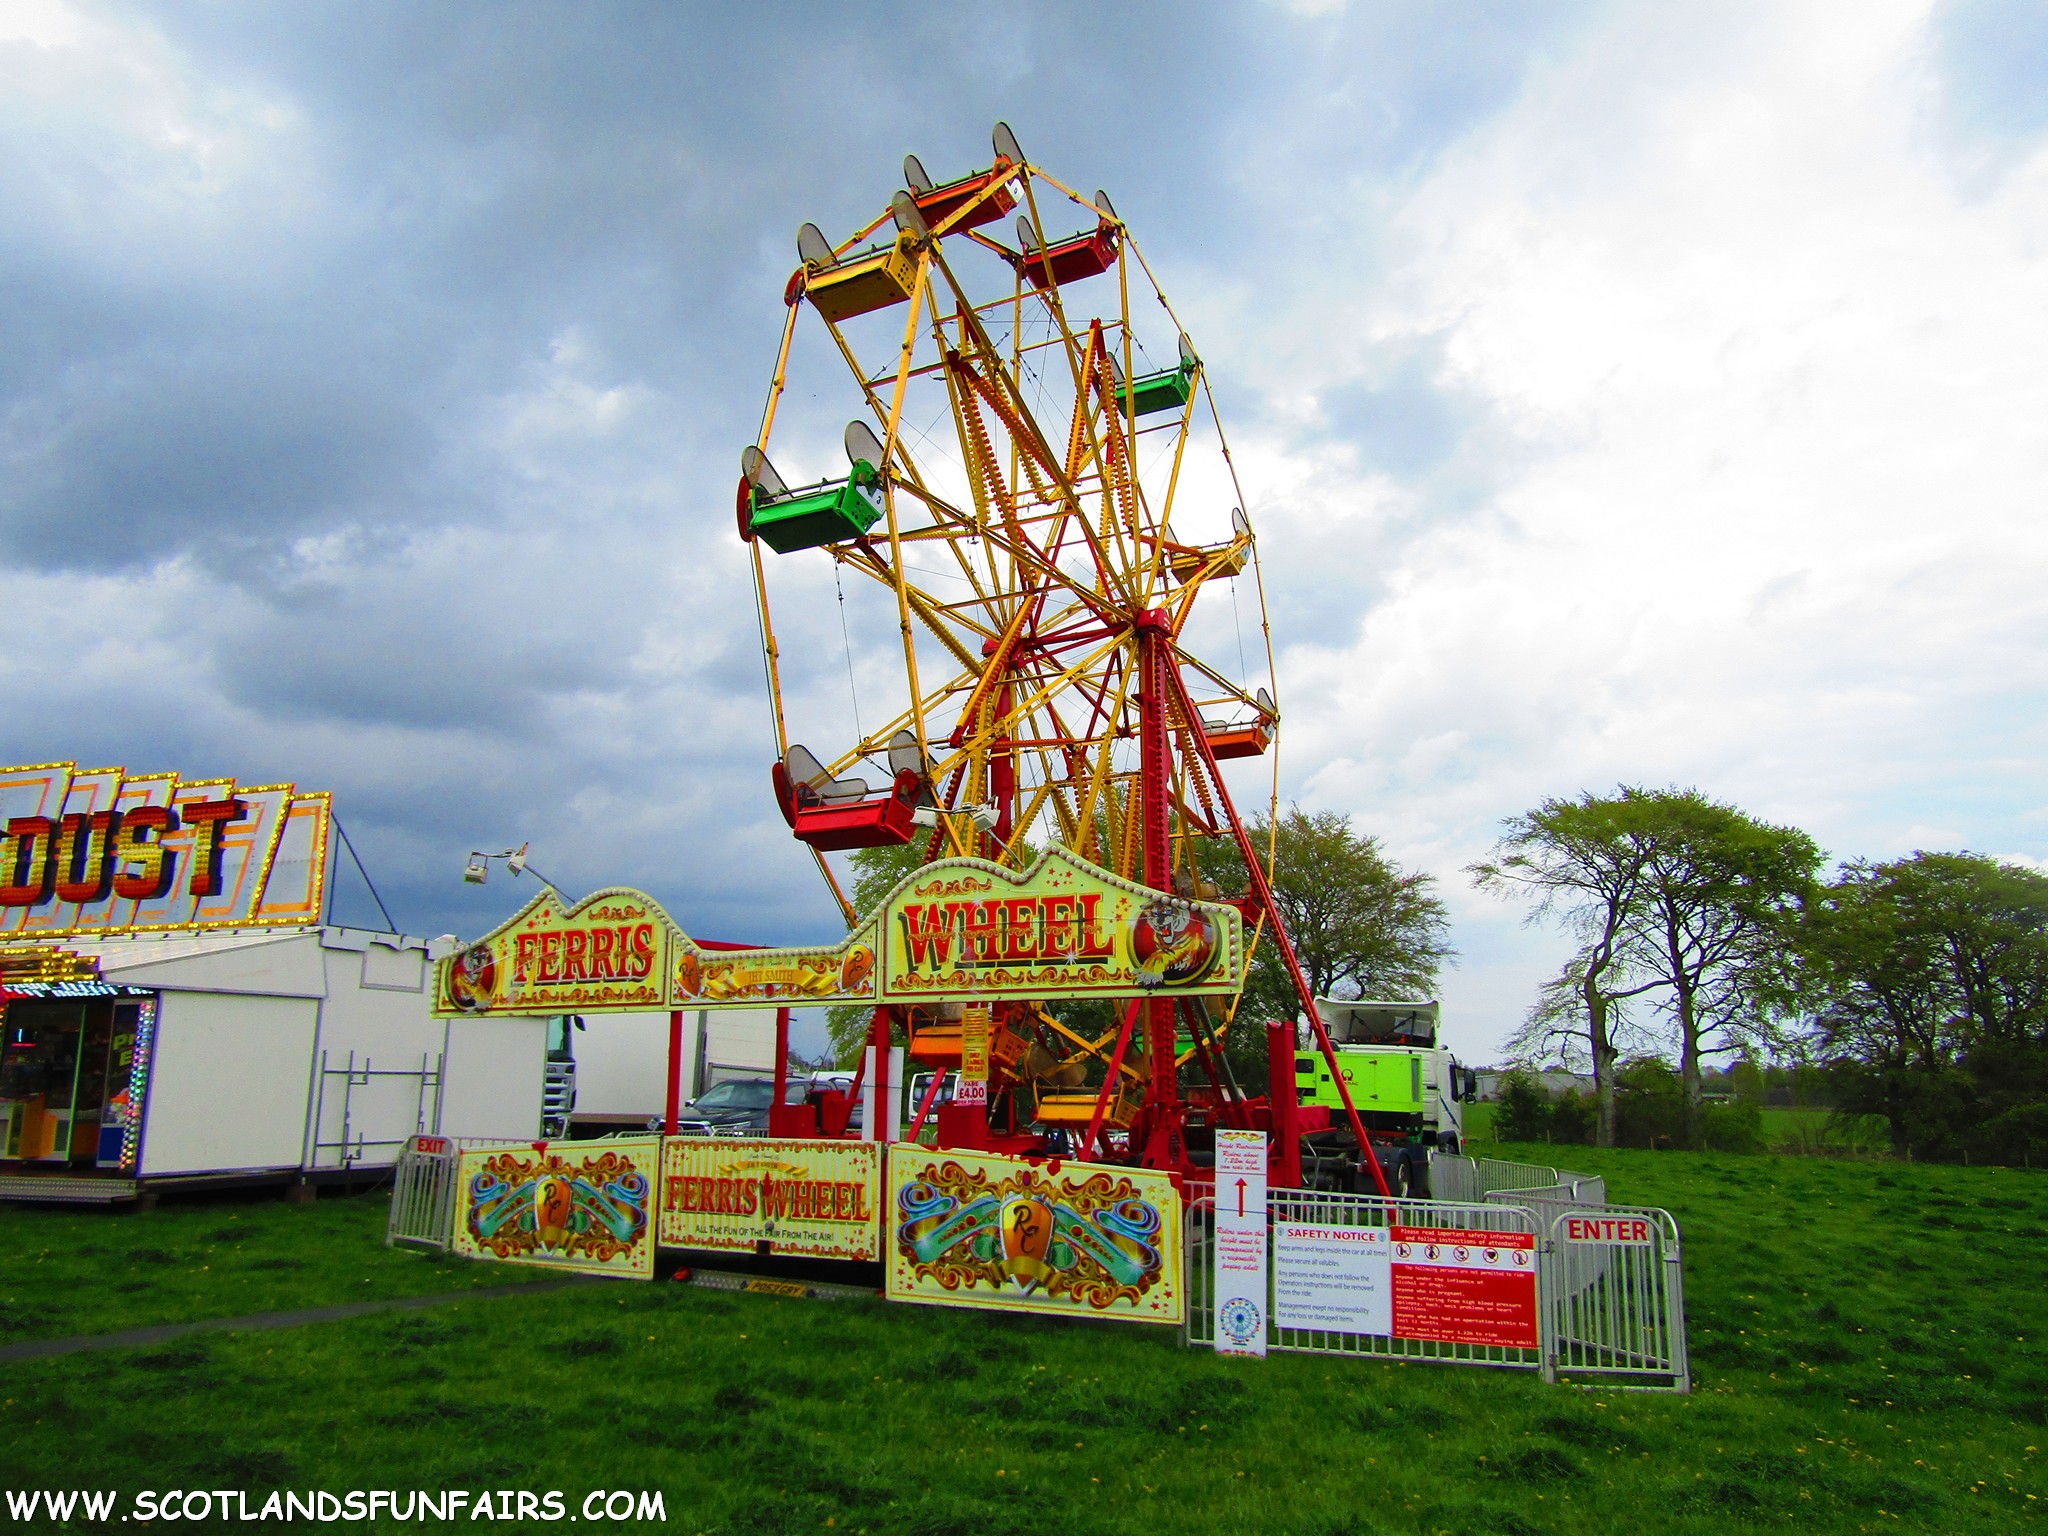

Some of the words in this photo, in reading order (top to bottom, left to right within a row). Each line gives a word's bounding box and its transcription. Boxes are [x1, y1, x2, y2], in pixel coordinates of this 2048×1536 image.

[901, 893, 1115, 969] WHEEL
[511, 923, 656, 985] FERRIS
[765, 970, 792, 981] SMITH
[959, 1087, 984, 1098] £4.00
[417, 1138, 446, 1154] EXIT
[665, 1176, 758, 1216] FERRIS
[760, 1179, 871, 1222] WHEEL
[696, 1225, 707, 1233] ALL
[709, 1225, 722, 1234] THE
[724, 1227, 738, 1235] FUN
[750, 1228, 763, 1236] THE
[782, 1230, 802, 1239] FROM
[803, 1231, 817, 1240] THE
[1288, 1229, 1330, 1239] SAFETY
[1333, 1231, 1375, 1241] NOTICE
[1437, 1230, 1465, 1238] important
[1568, 1219, 1648, 1240] ENTER
[1278, 1302, 1311, 1310] Management
[1314, 1314, 1338, 1322] damaged
